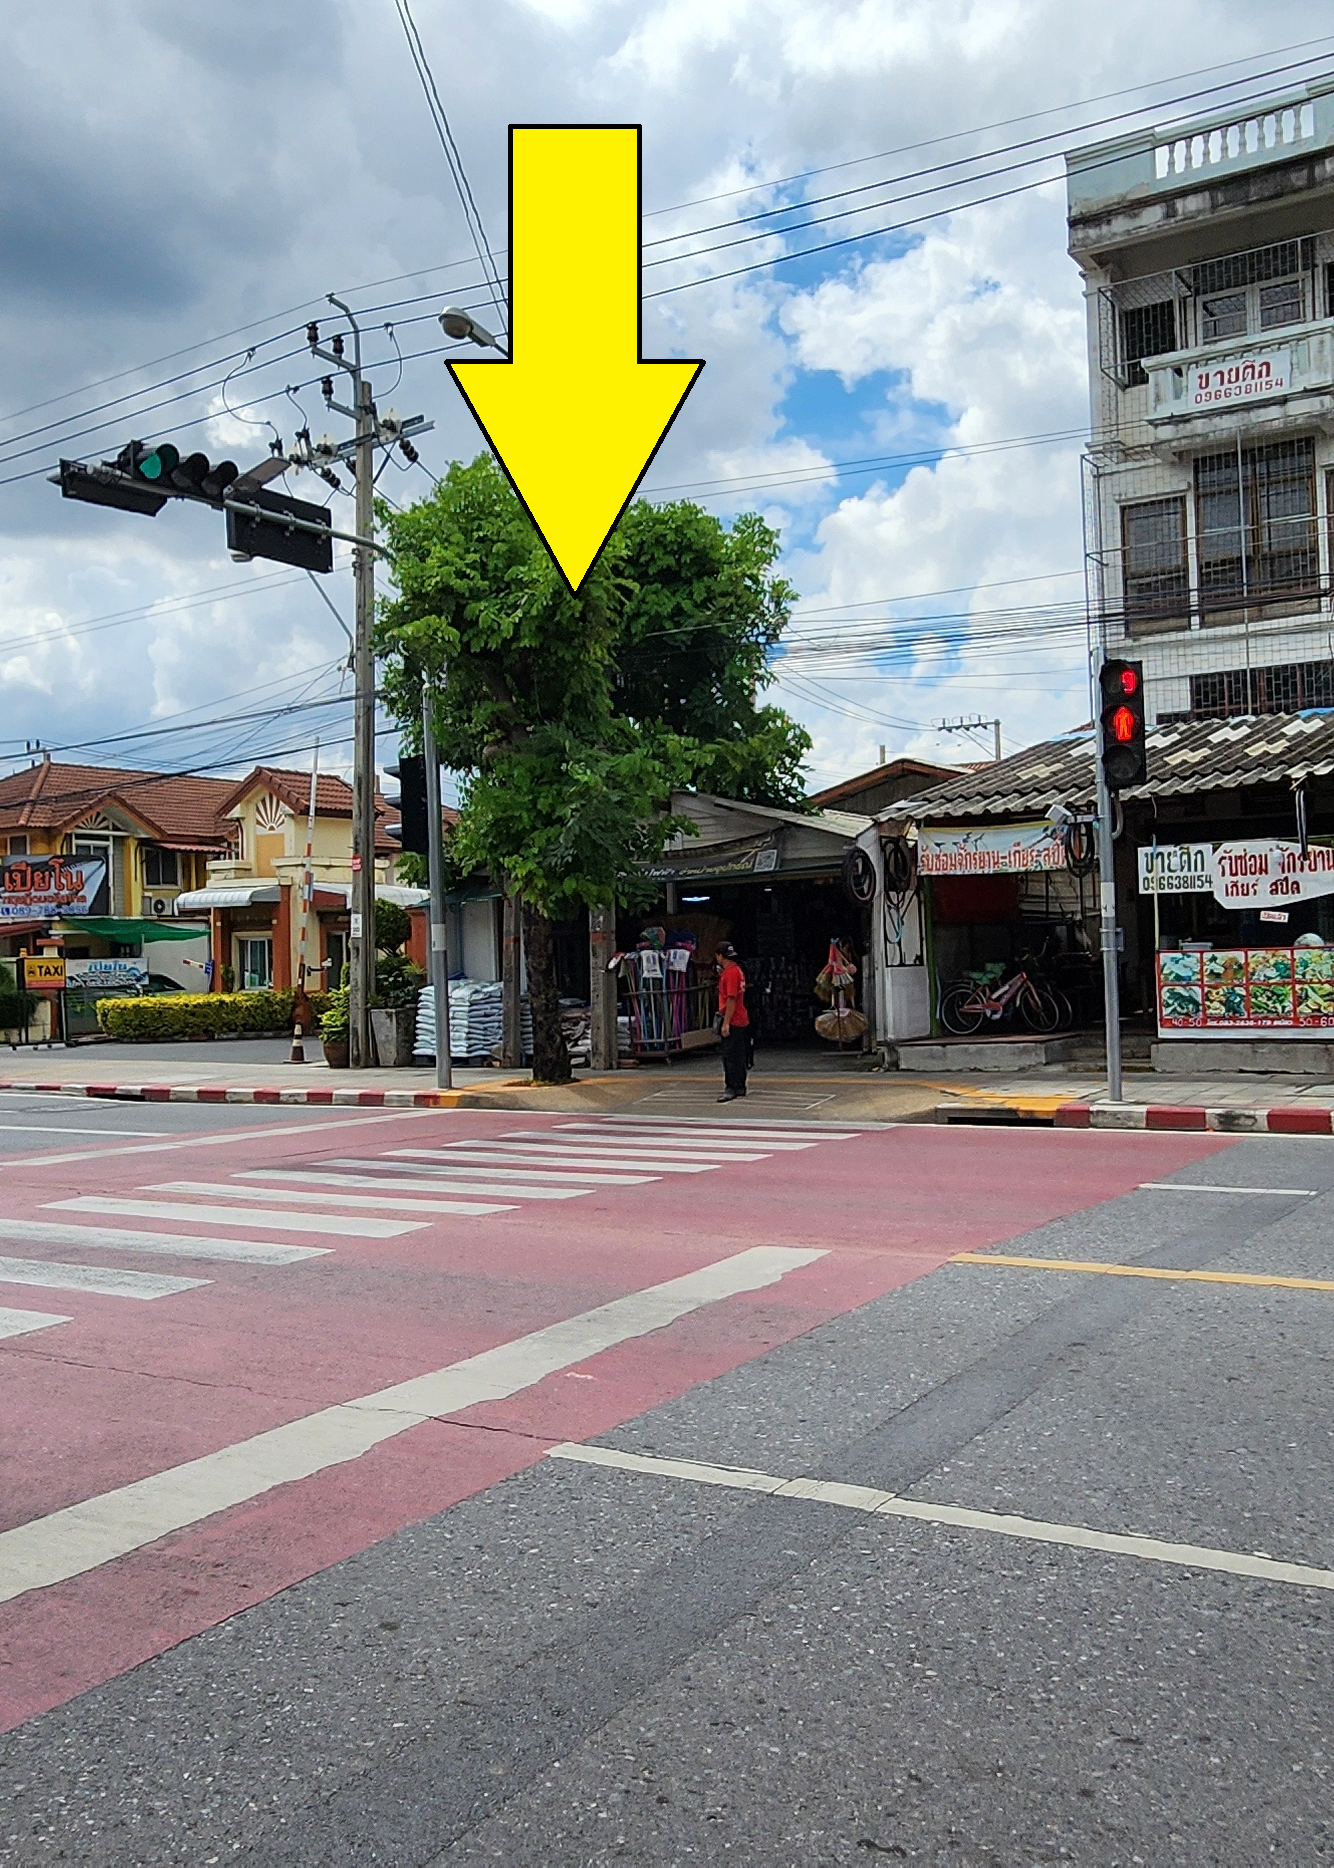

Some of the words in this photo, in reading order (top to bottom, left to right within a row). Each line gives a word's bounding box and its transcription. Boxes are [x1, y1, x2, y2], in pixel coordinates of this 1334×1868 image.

[1194, 377, 1283, 404] 0966381154
[1121, 670, 1136, 694] 9
[3, 857, 85, 892] เปียโน
[36, 964, 64, 978] TAXI
